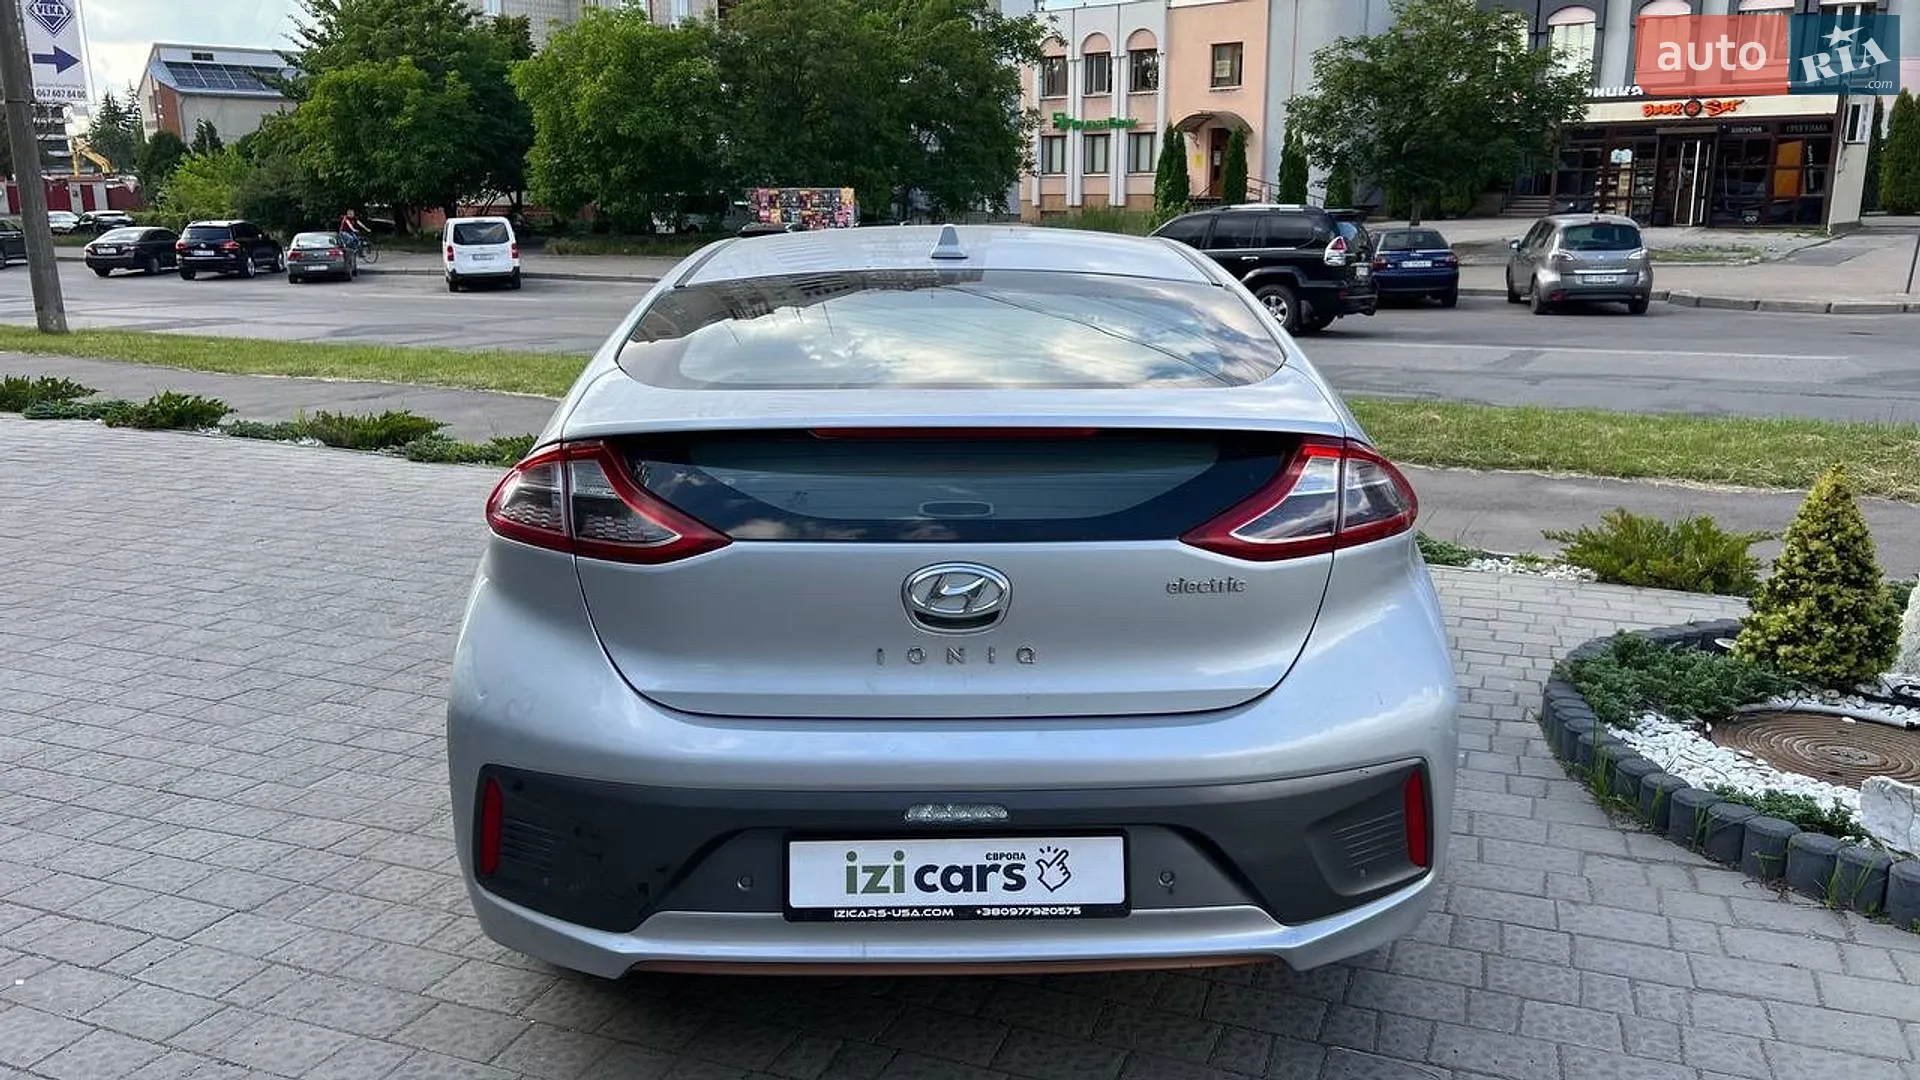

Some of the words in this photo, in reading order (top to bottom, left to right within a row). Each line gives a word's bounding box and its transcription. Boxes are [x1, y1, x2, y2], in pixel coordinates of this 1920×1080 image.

[36, 4, 65, 15] VEKA
[1166, 577, 1246, 594] electric
[876, 647, 1036, 665] IONIQ
[985, 852, 1026, 860] ЄВРОПА
[845, 850, 905, 894] izi
[914, 863, 1027, 893] cars
[834, 908, 954, 918] IZICARS-USA.COM
[976, 906, 1081, 917] +380977920575
